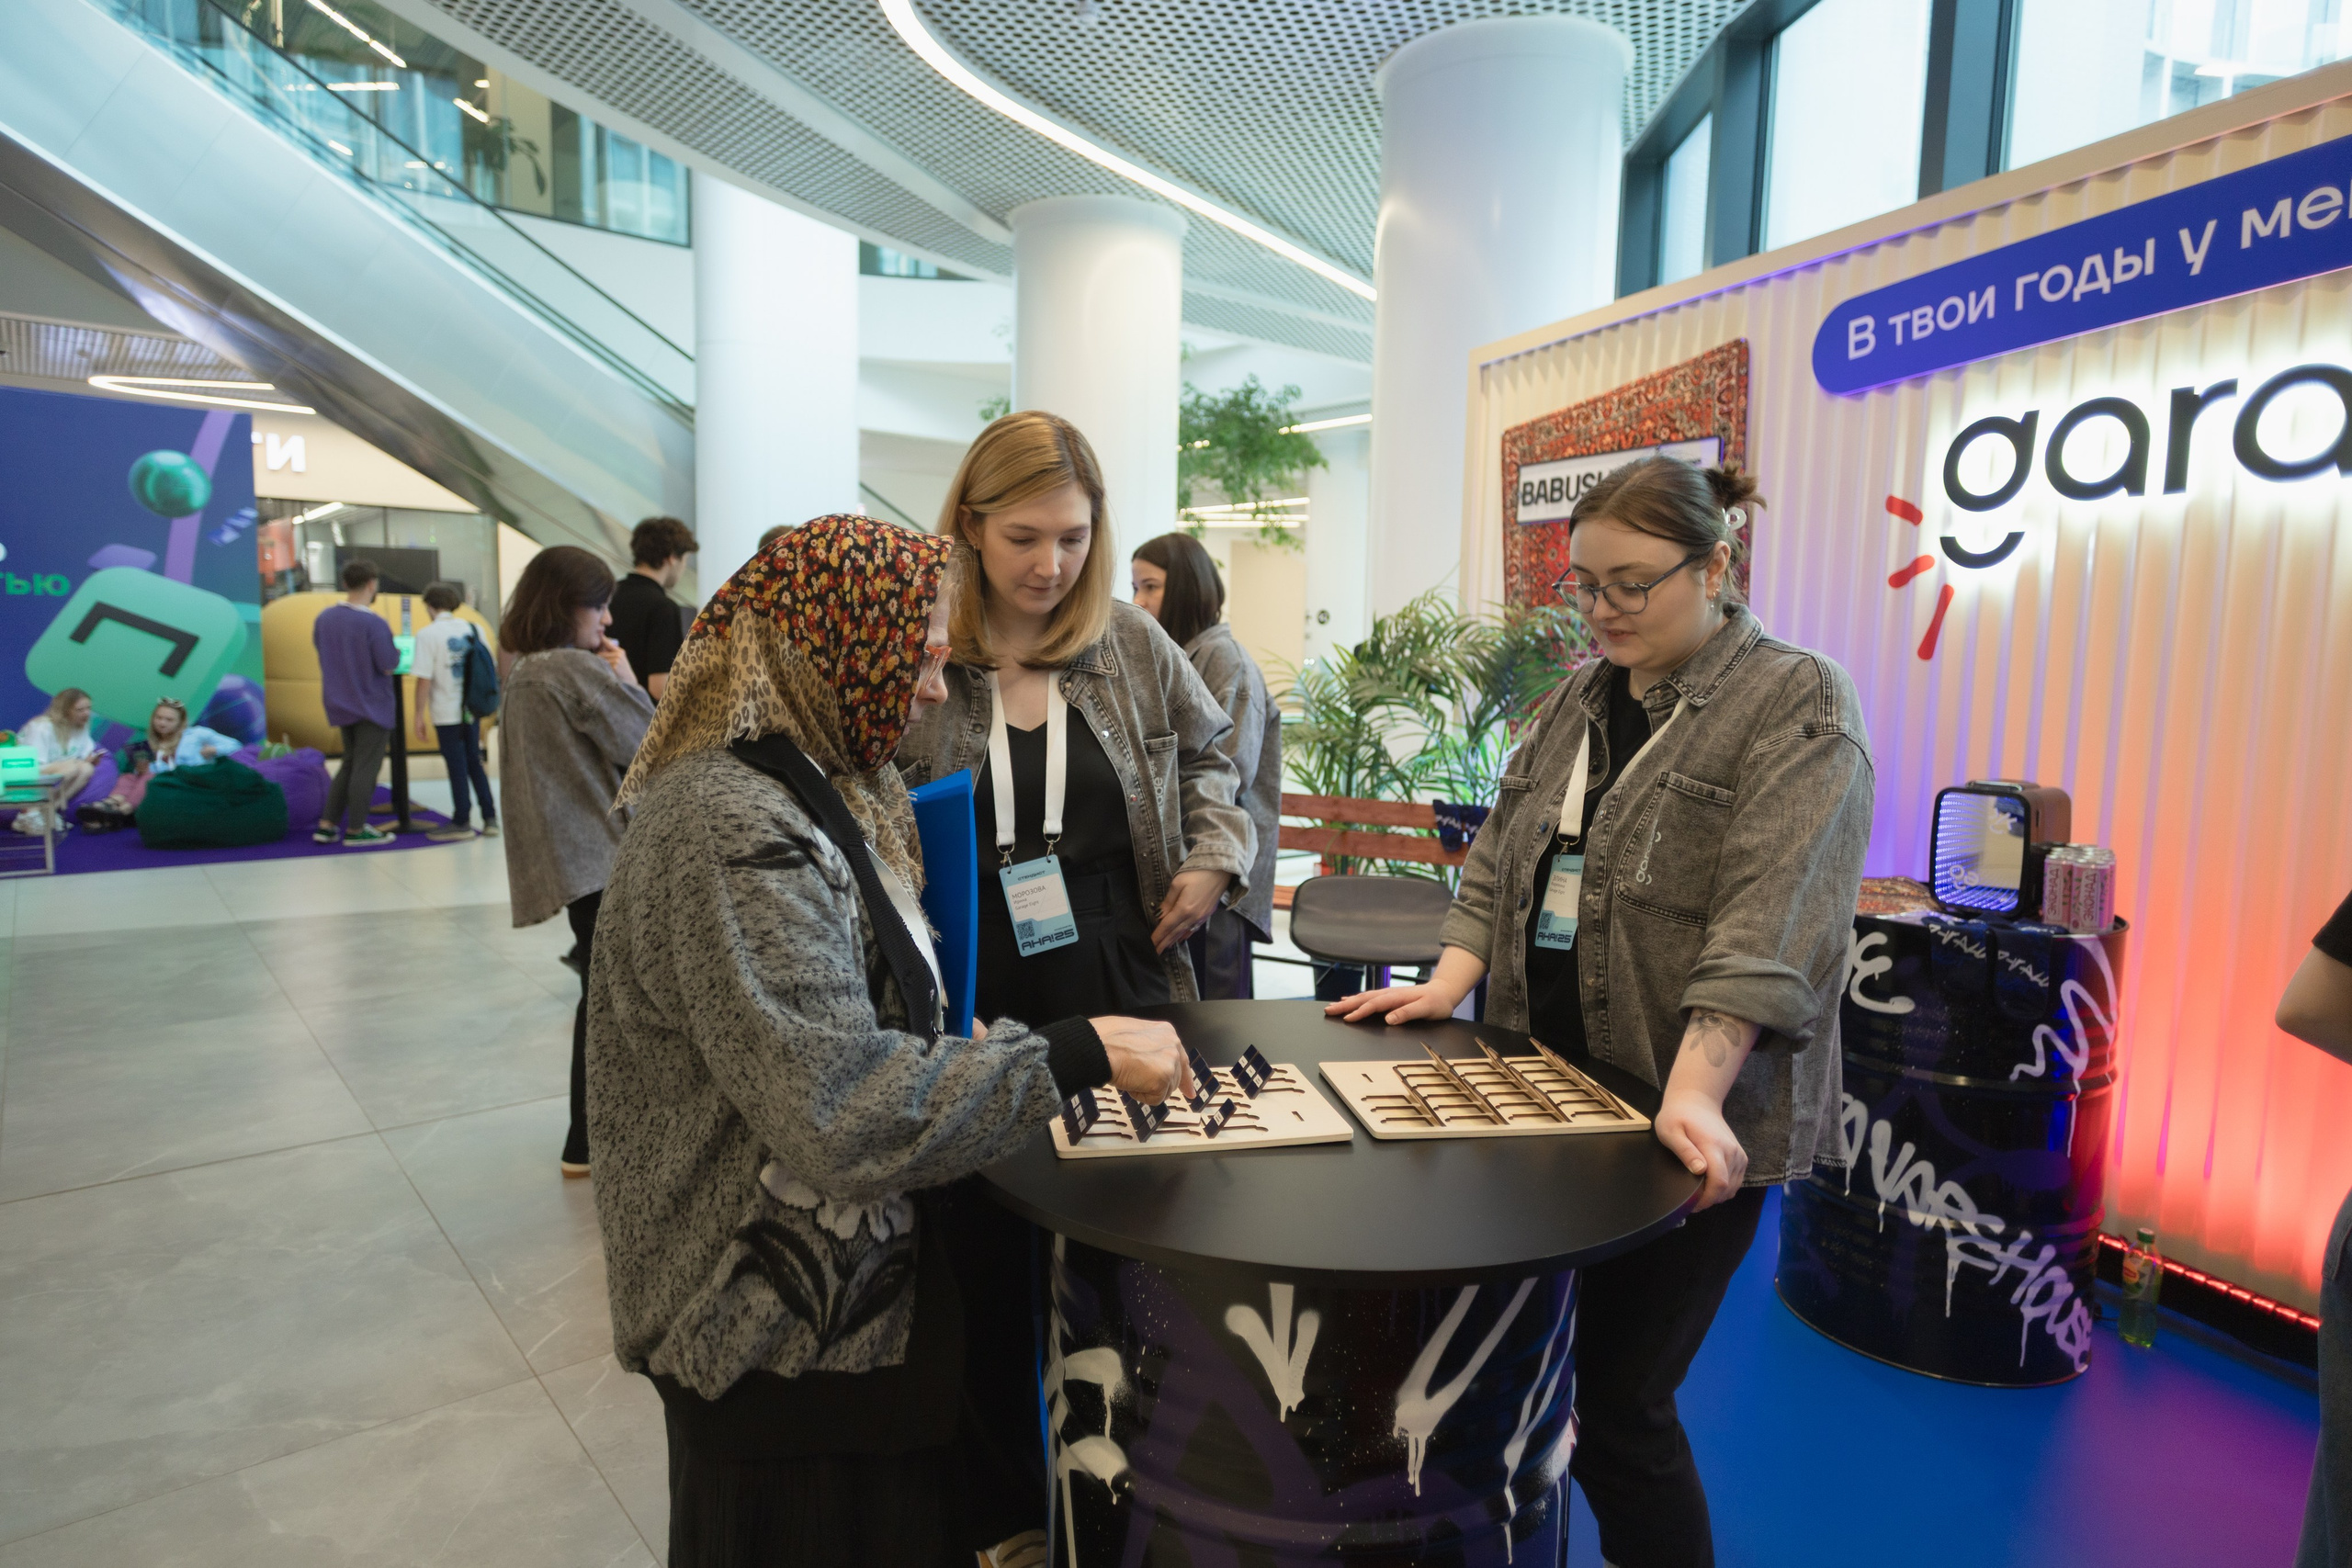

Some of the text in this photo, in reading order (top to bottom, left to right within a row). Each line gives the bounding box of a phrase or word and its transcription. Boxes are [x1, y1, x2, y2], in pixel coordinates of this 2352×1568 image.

[1848, 176, 2352, 361] В твои годы у ме
[1521, 470, 1603, 507] BABUS
[1012, 885, 1046, 900] МОРОЗОВА
